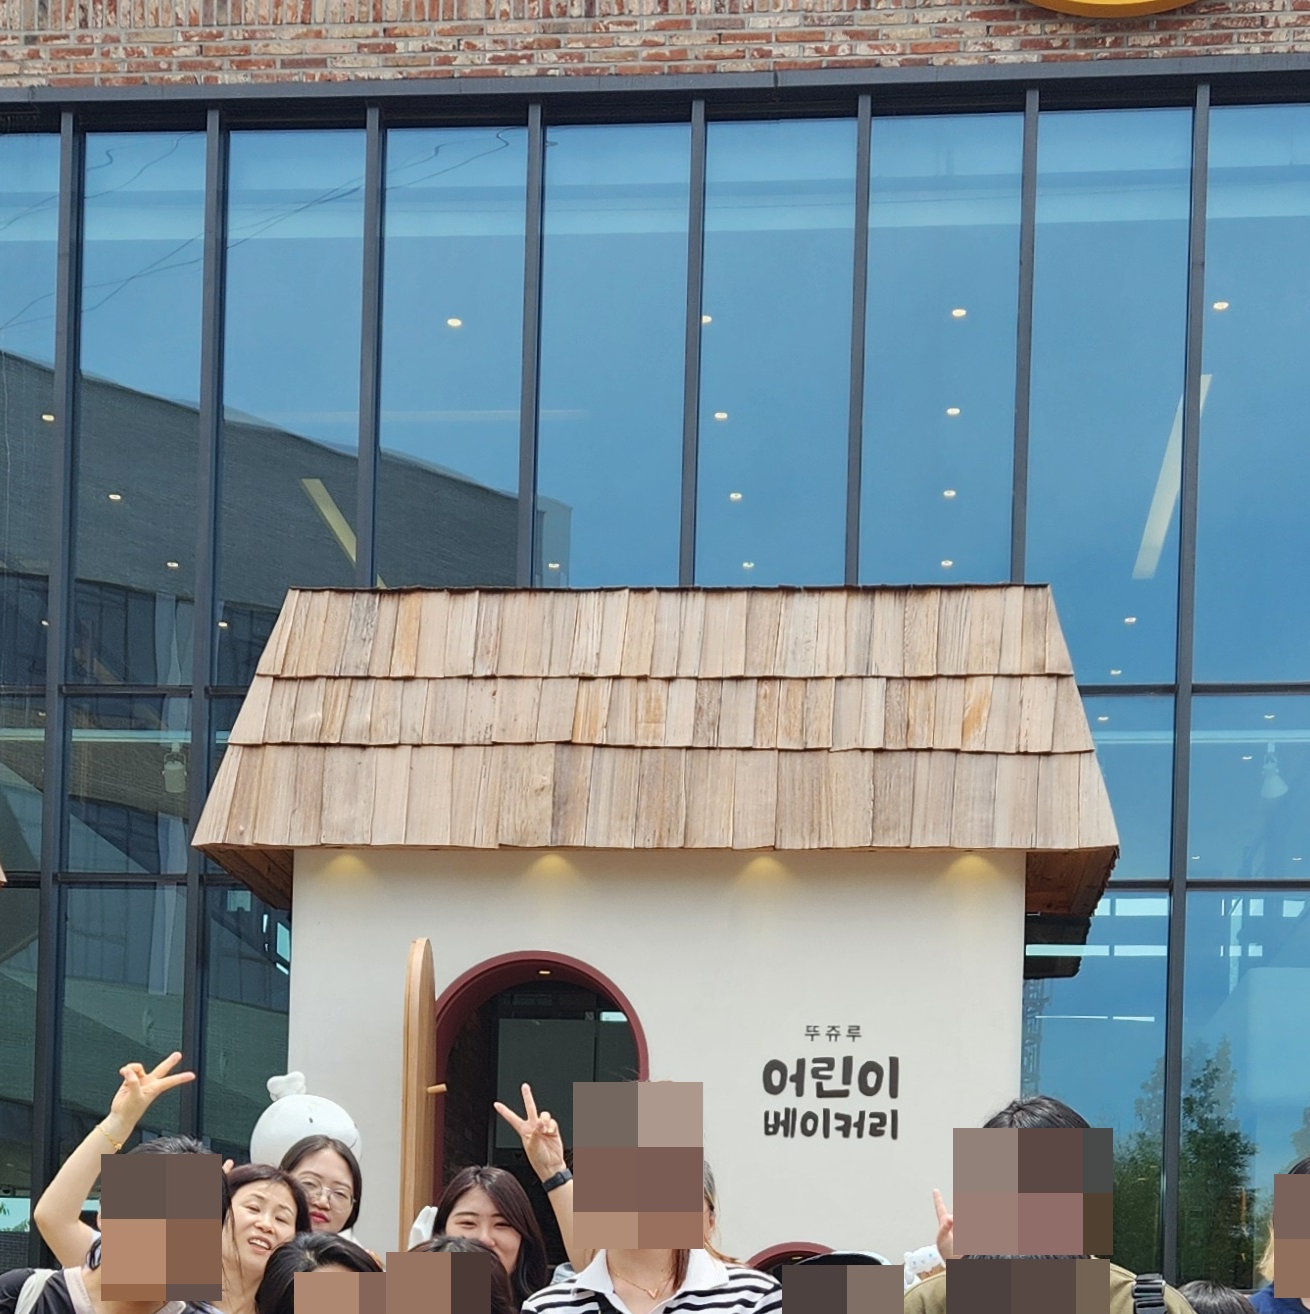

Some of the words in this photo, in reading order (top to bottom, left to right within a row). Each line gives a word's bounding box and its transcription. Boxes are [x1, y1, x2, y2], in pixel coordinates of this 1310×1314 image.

[804, 1025, 862, 1042] 뚜쥬루
[762, 1055, 899, 1099] 어린이
[764, 1107, 898, 1140] 베이커리
